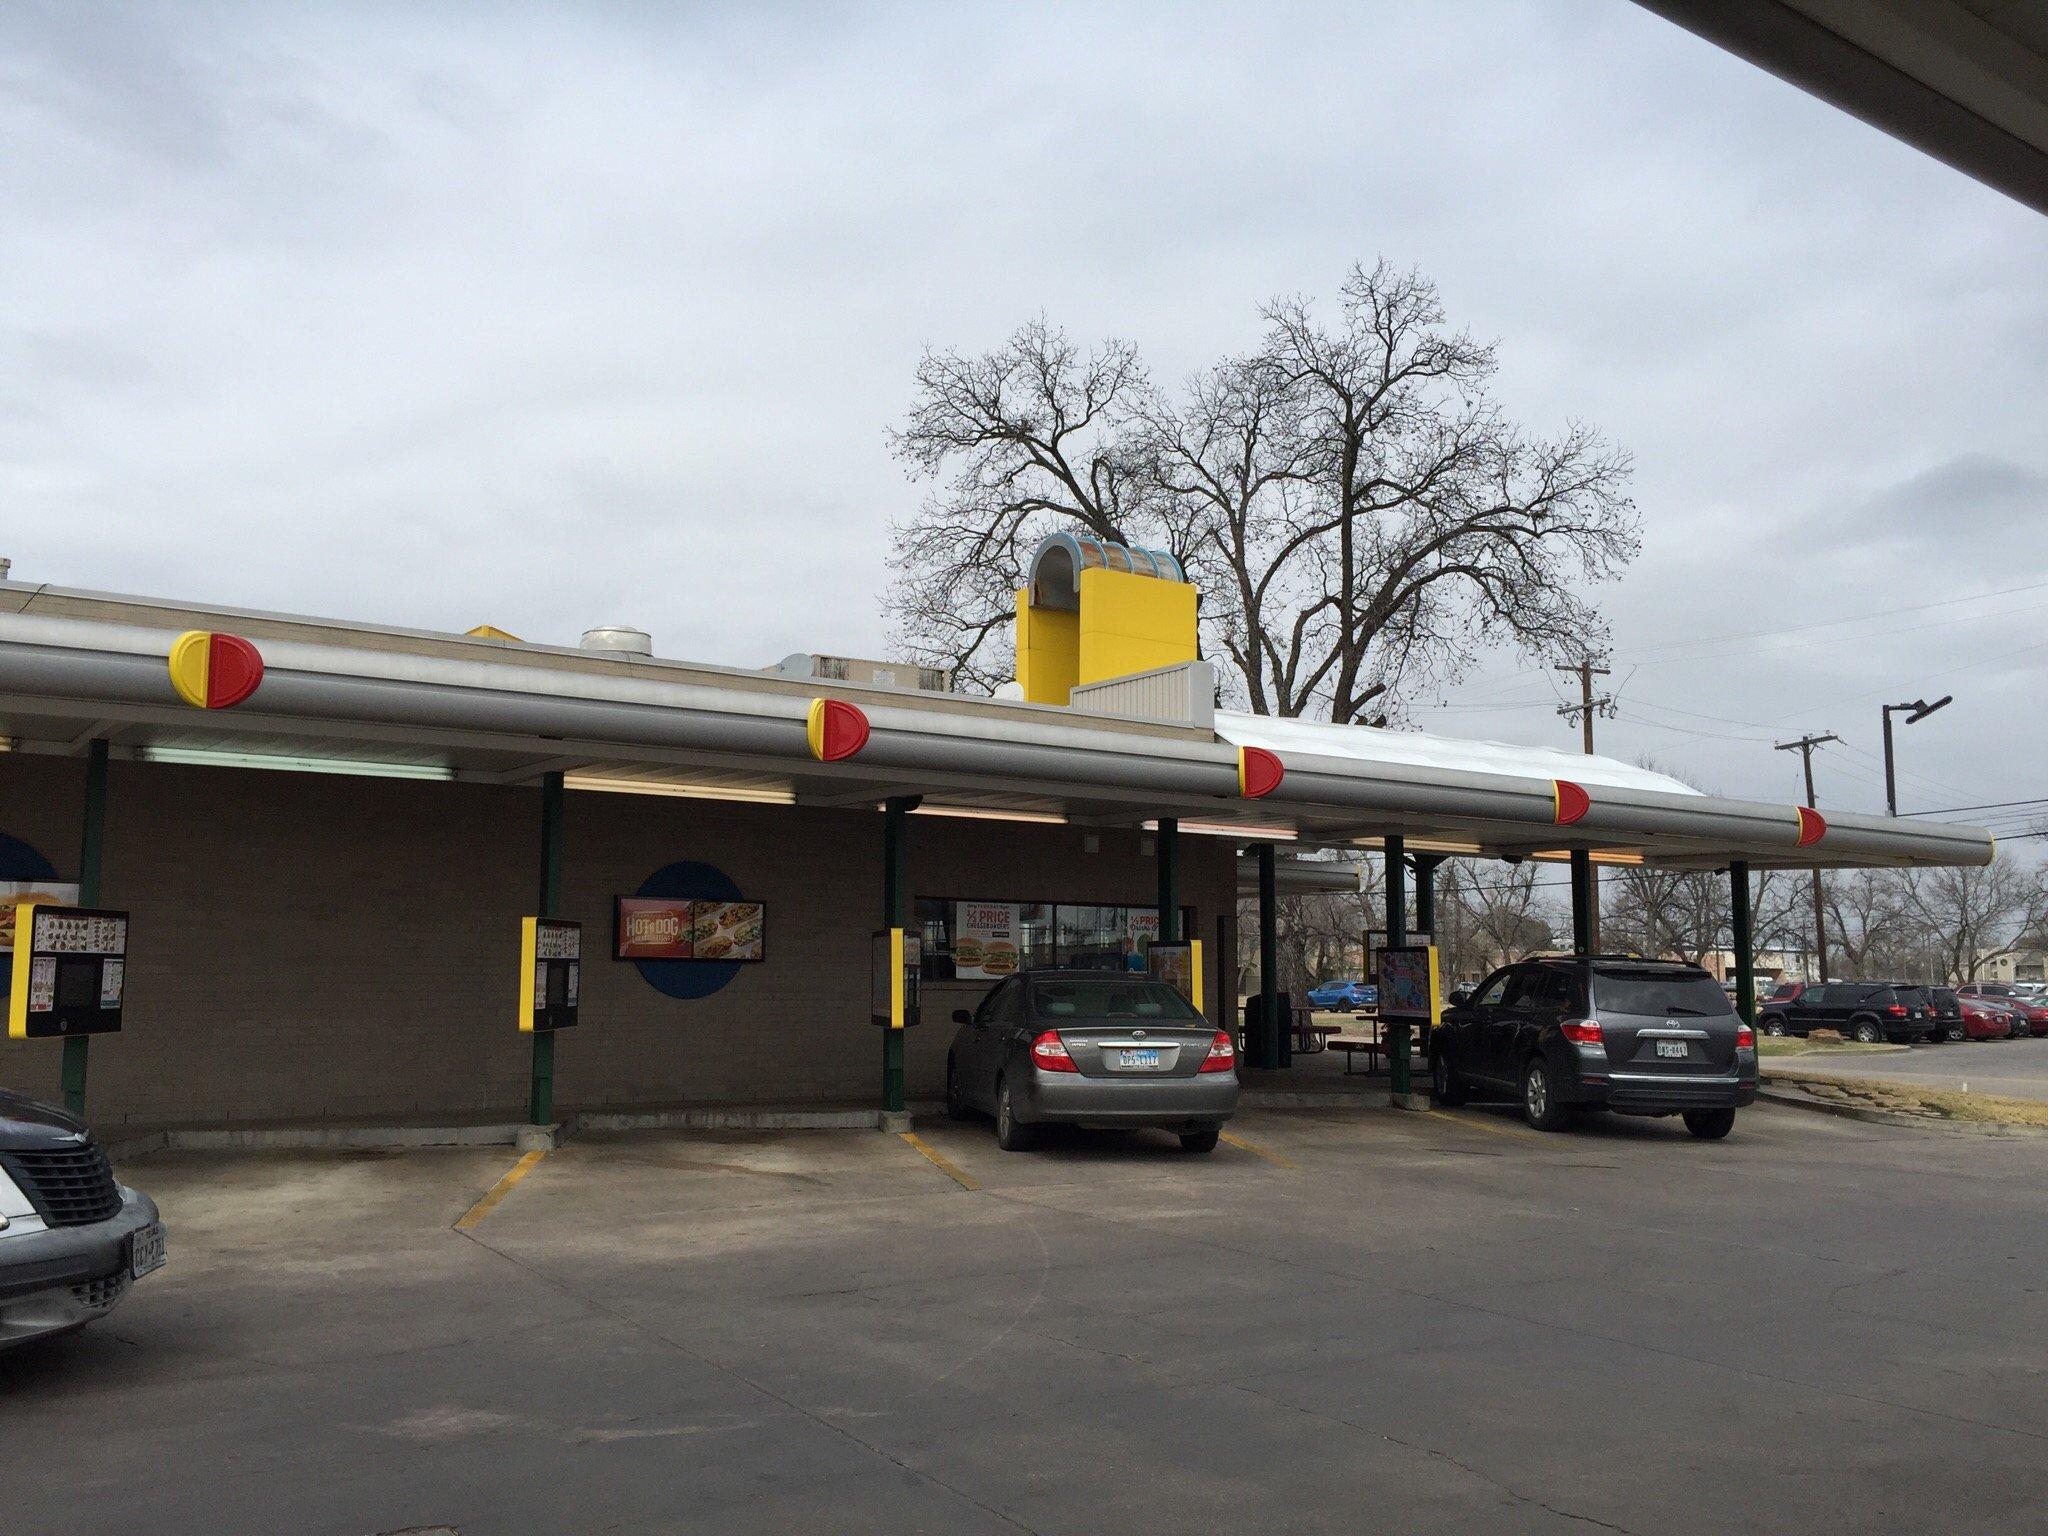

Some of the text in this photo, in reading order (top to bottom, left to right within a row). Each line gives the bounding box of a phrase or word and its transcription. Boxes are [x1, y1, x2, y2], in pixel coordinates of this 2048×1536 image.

[979, 910, 1010, 924] PRICE
[1139, 915, 1160, 926] PRIC
[626, 917, 679, 937] HOT DOG
